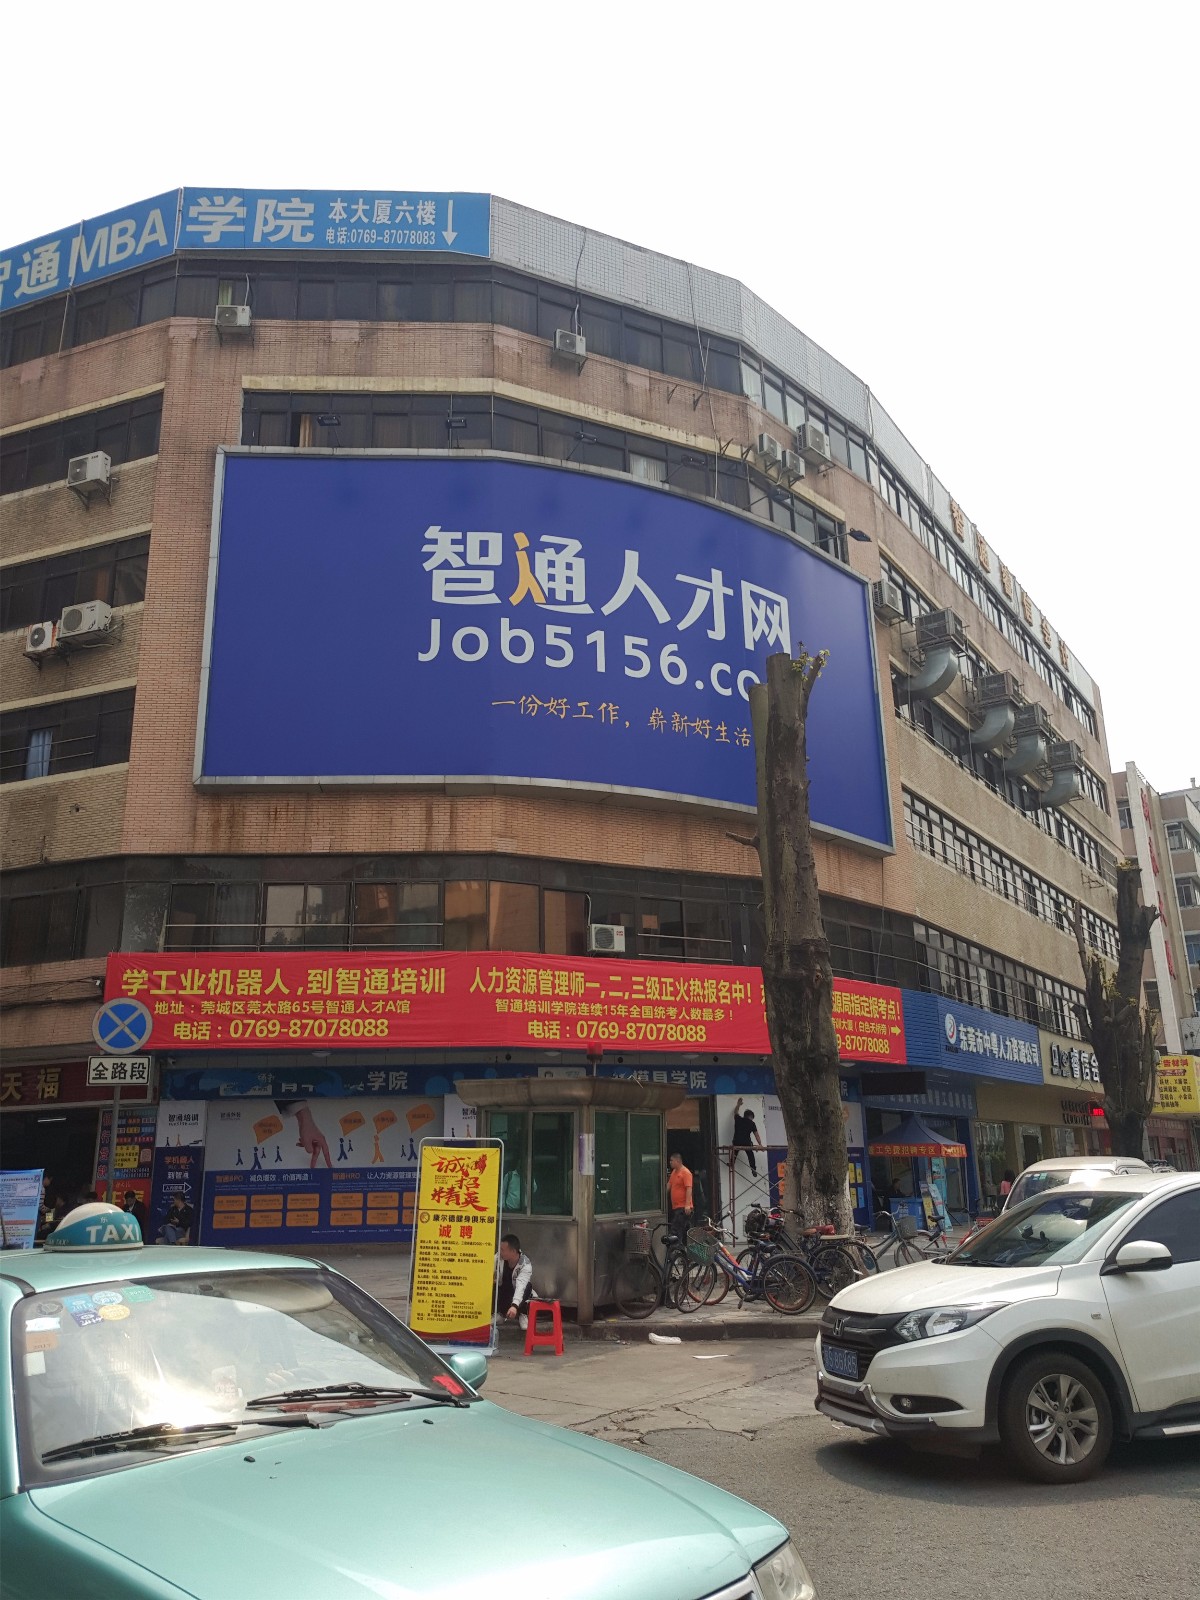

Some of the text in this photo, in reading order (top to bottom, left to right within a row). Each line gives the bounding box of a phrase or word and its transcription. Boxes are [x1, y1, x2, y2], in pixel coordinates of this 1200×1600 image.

[185, 195, 315, 244] 学院
[328, 198, 436, 227] 本大厦六楼
[421, 525, 793, 657] 智通人才网
[173, 1017, 389, 1041] 电话：0769-87078088
[527, 1019, 707, 1042] 电话：0769-87078088
[2, 1067, 62, 1100] 天福
[92, 1061, 147, 1081] 全路段
[86, 1223, 140, 1244] TAXI
